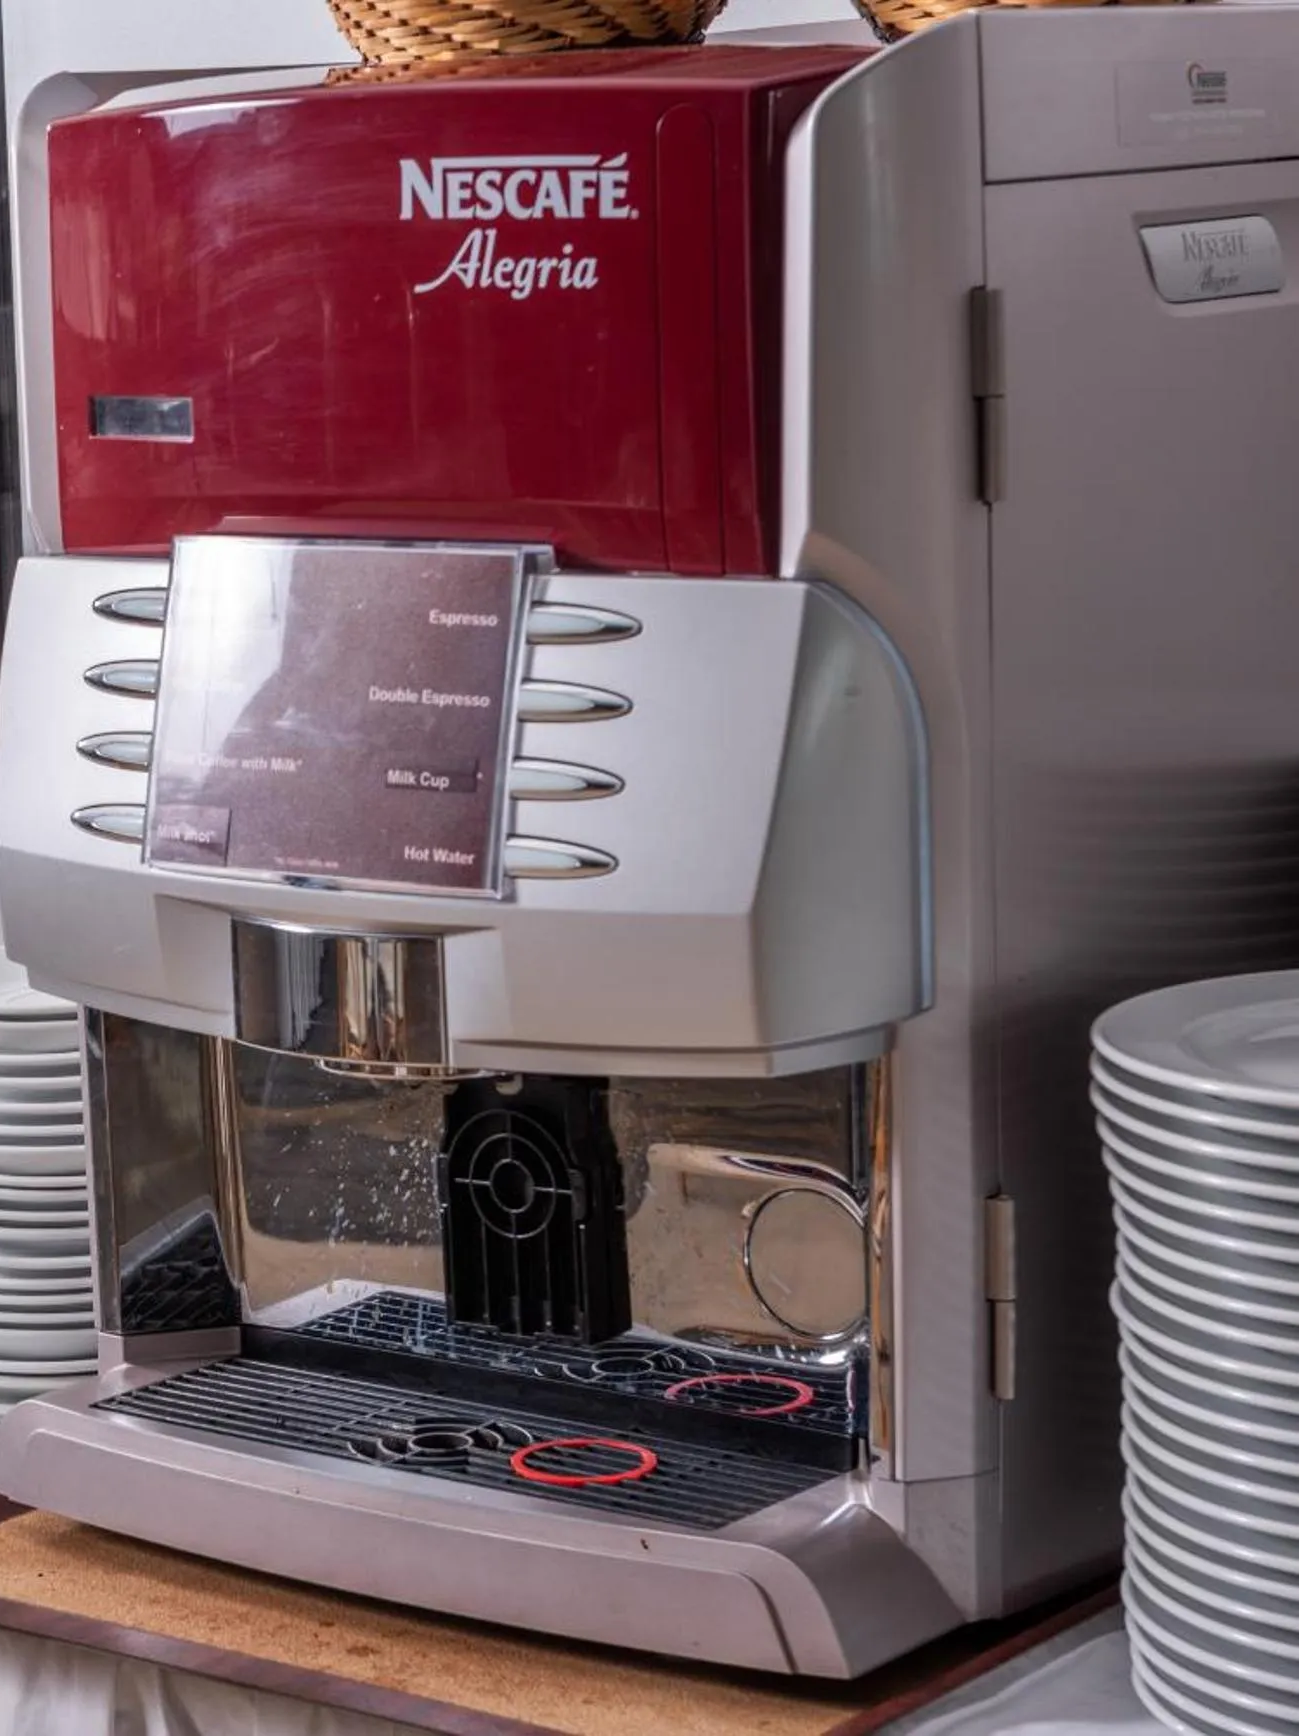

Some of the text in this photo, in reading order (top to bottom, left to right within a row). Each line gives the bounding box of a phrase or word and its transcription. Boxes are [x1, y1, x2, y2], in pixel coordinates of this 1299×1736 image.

[413, 227, 599, 300] Alegria
[429, 609, 499, 628] Espresso
[369, 686, 491, 708] Double Espresso
[387, 769, 450, 791] Milk Cup
[403, 845, 476, 866] Hot Water
